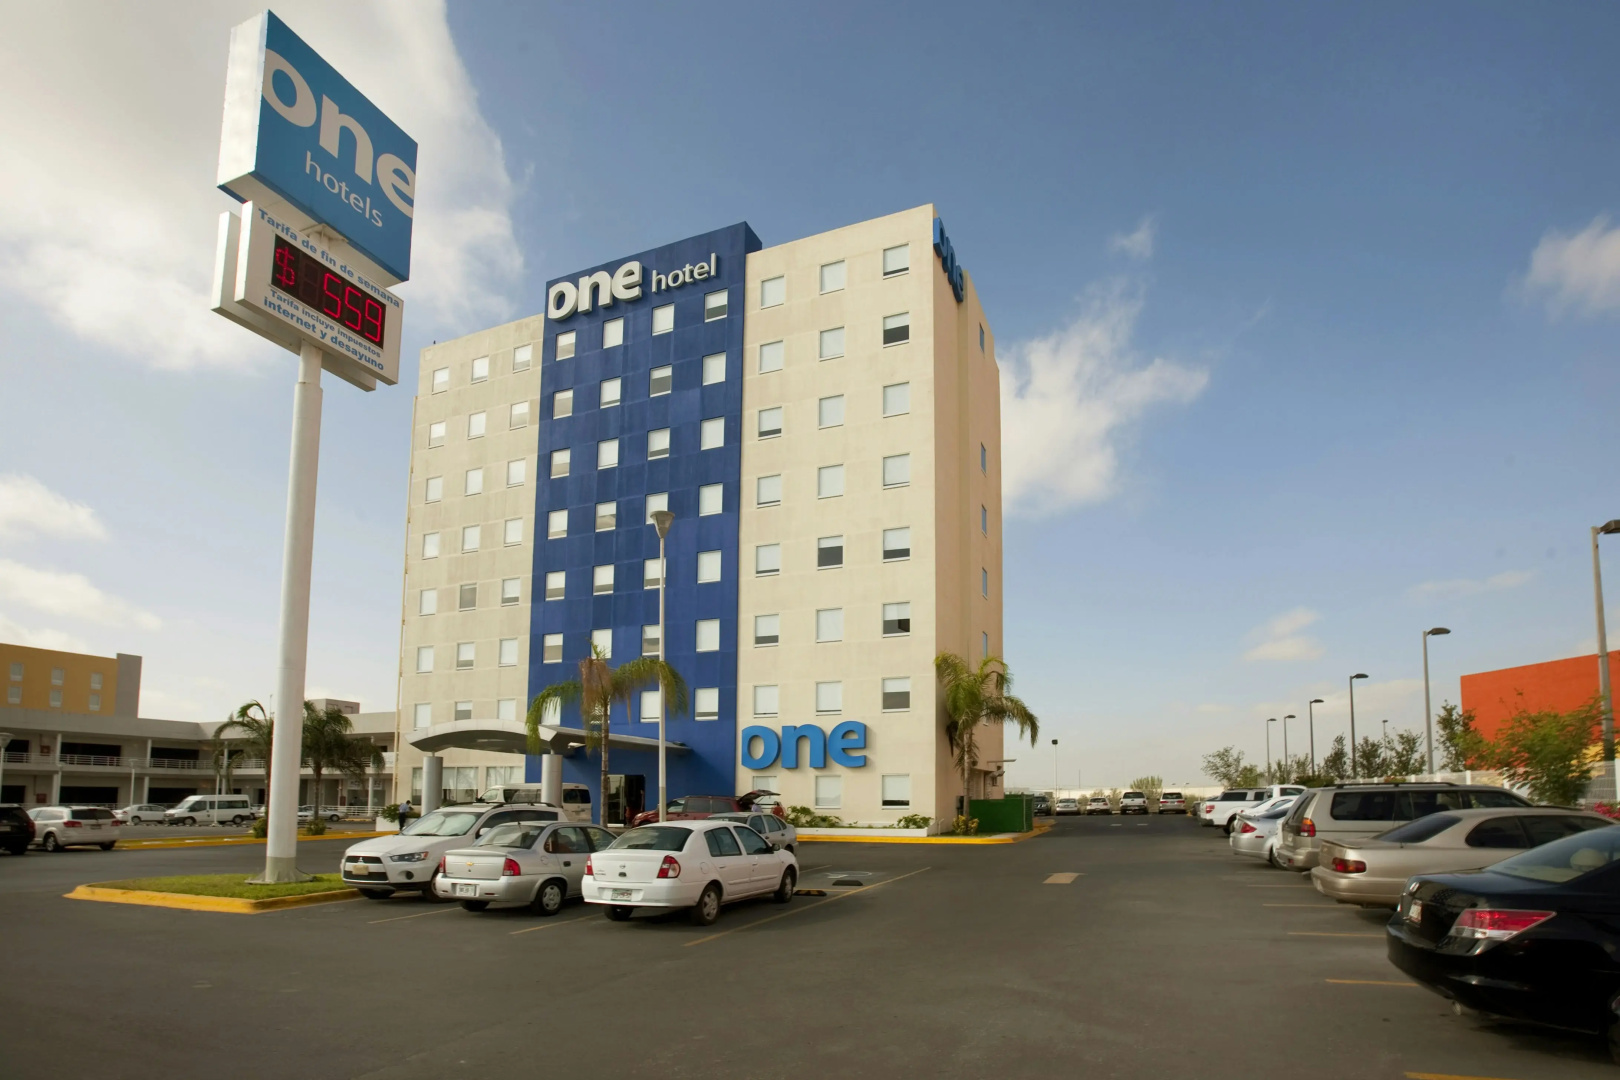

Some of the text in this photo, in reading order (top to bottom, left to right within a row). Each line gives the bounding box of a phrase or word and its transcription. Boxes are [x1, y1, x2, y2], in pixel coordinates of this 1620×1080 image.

[262, 48, 416, 219] one
[305, 150, 383, 227] hotels
[258, 208, 400, 308] Tarifa de fin de semana
[275, 247, 382, 342] $ 559
[547, 252, 717, 321] one hotel
[933, 217, 964, 303] one
[263, 296, 385, 371] internet y desayuno
[270, 289, 381, 358] Tarifa incluye impuestos
[741, 721, 867, 770] one
